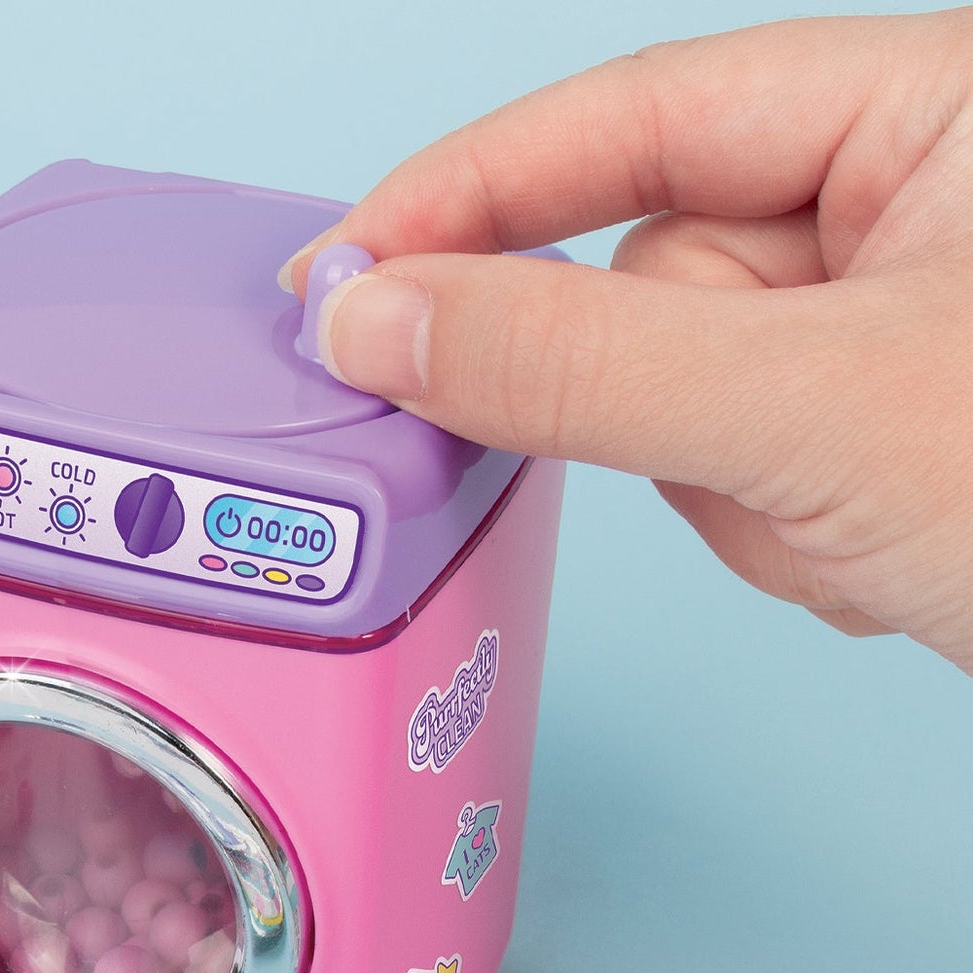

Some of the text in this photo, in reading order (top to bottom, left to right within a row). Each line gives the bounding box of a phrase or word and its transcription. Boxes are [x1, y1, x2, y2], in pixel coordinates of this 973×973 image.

[50, 461, 97, 487] COLD
[246, 516, 326, 553] 00:00
[414, 644, 495, 759] Purrfectly
[436, 692, 484, 763] CLEAN
[466, 843, 491, 880] CATS
